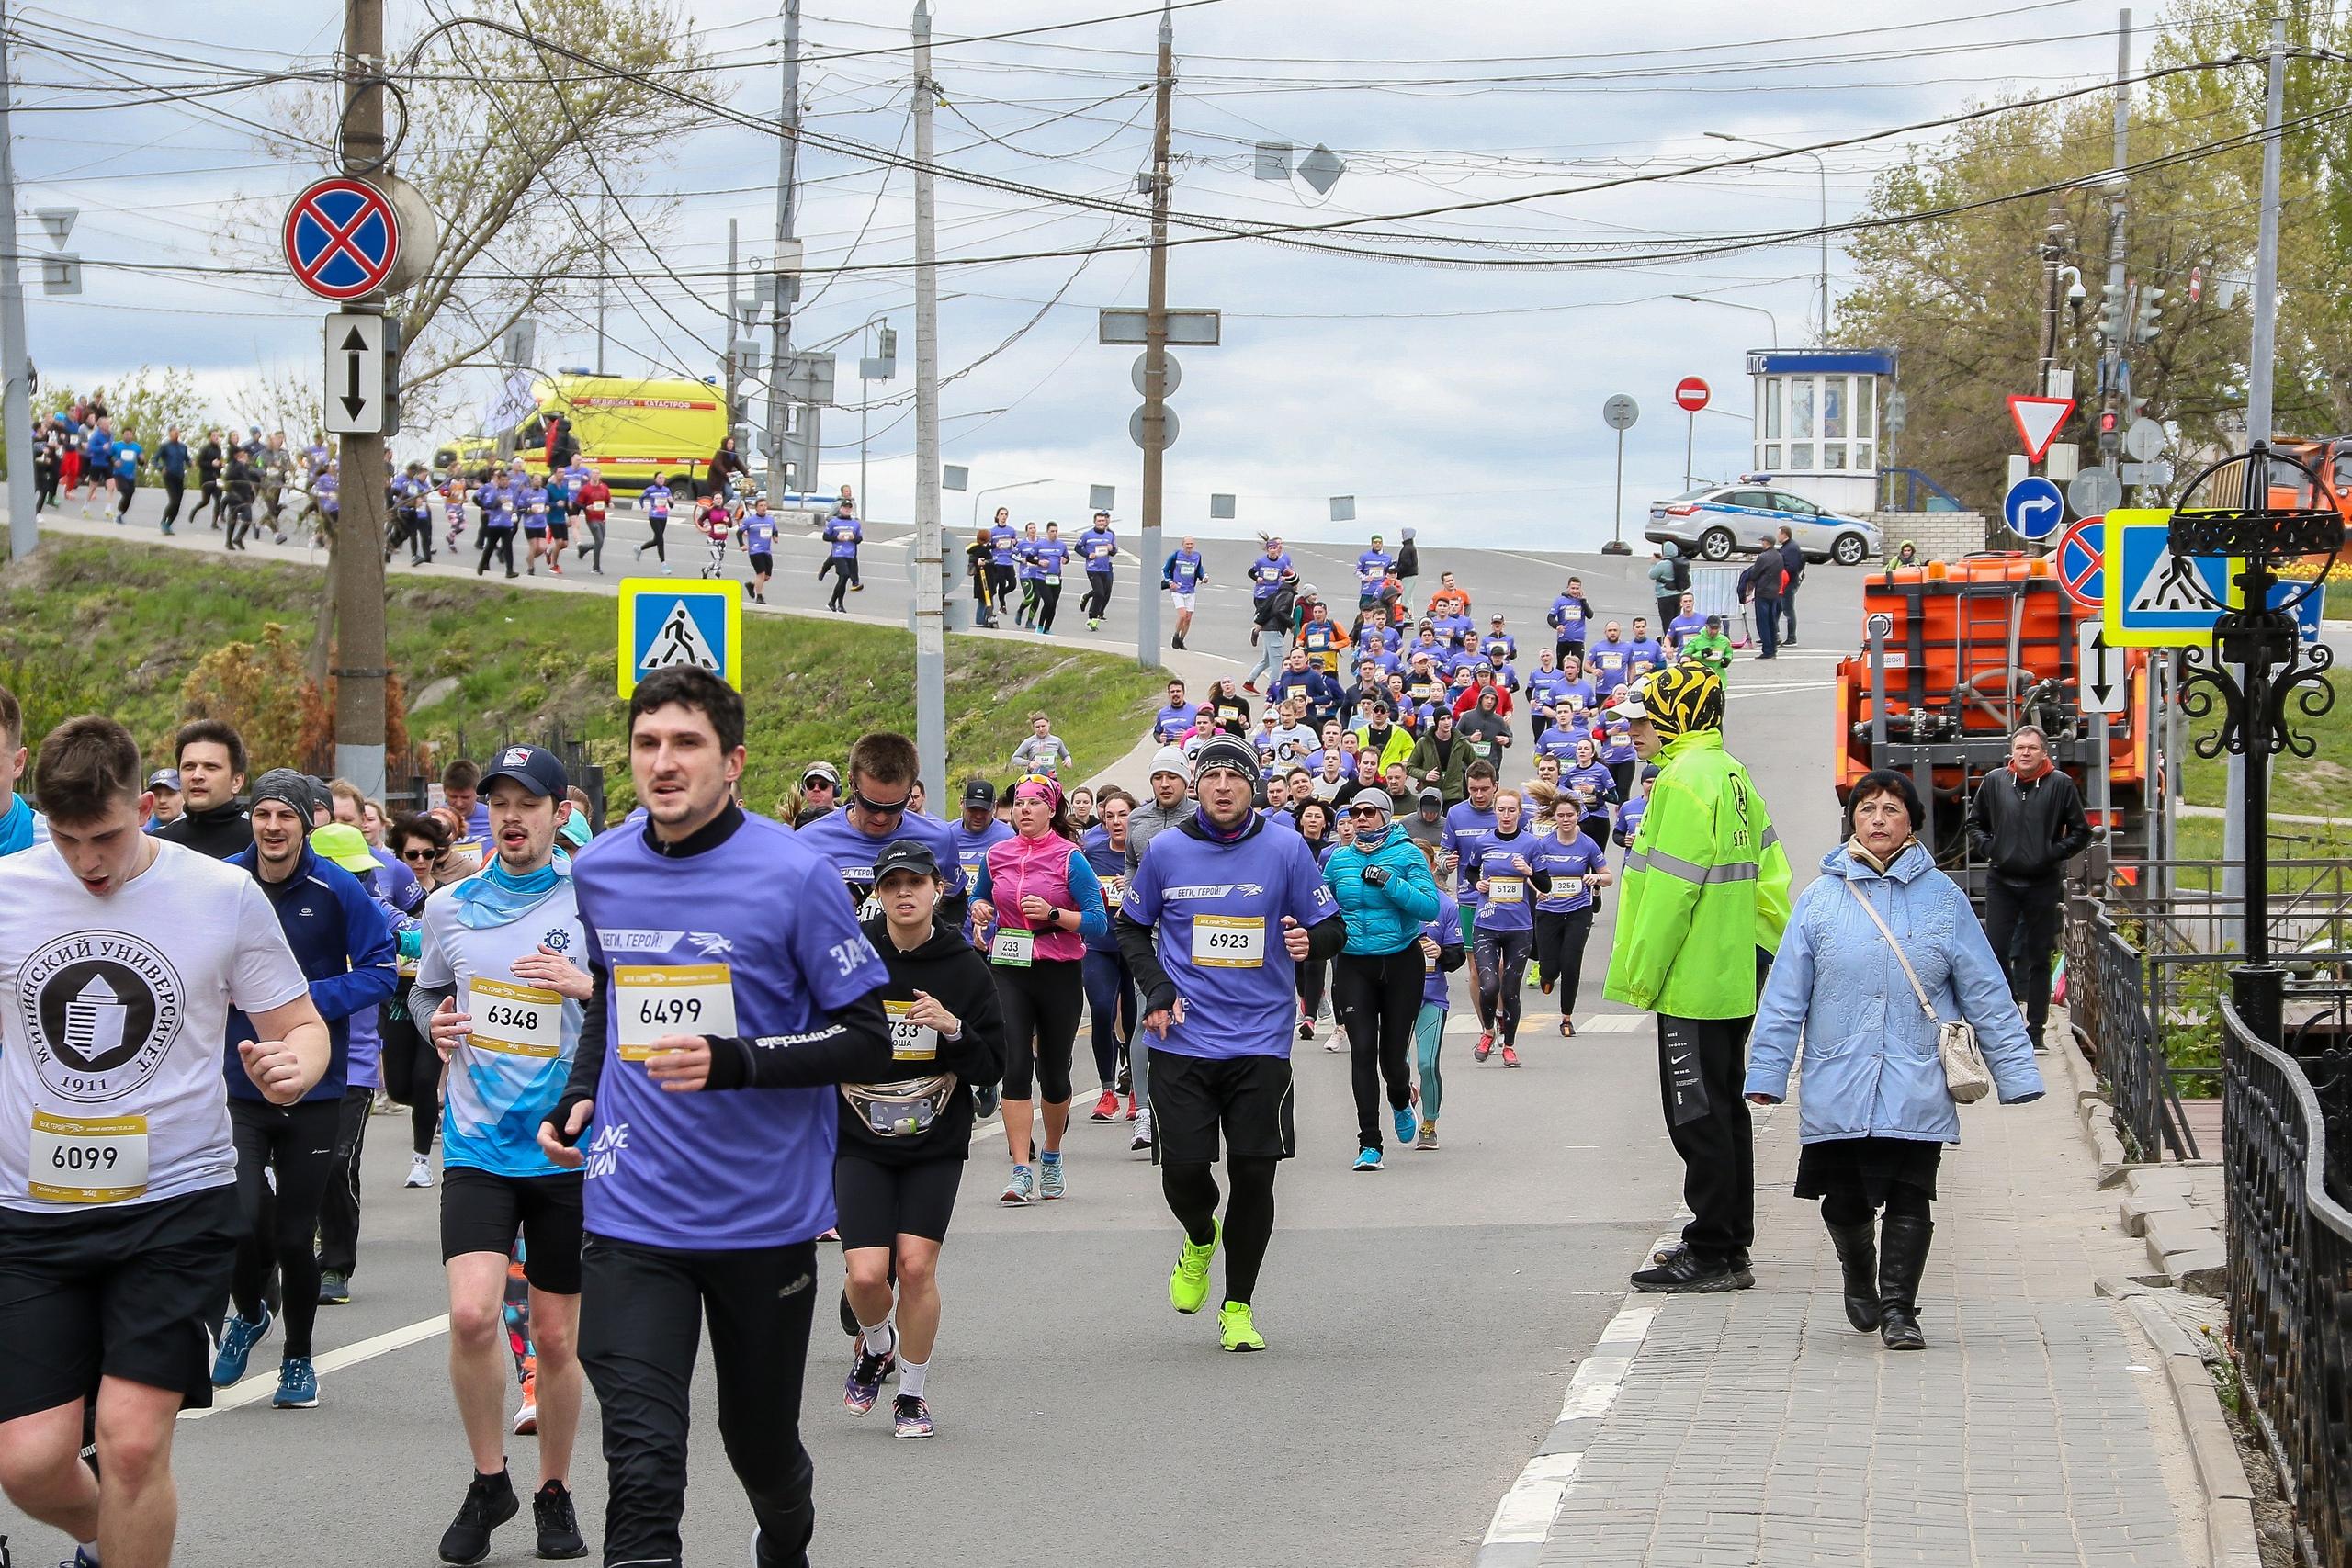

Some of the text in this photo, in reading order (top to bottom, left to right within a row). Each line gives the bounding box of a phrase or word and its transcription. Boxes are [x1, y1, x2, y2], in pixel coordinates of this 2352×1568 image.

[644, 400, 691, 409] КАТАСТРОФ
[1177, 886, 1222, 897] БЕГИ, ГЕРОЙ!
[1480, 907, 1495, 919] RUN
[602, 931, 663, 948] БЕГИ, ГЕРОЙ!
[1002, 941, 1019, 952] 233
[1209, 933, 1249, 949] 6923
[22, 939, 176, 1073] МИНИНСКИЙ УНИВЕРСИТЕТ
[640, 998, 702, 1024] 6499
[488, 1005, 538, 1030] 6348
[892, 1039, 912, 1047] ОША
[61, 1076, 109, 1092] 1911
[51, 1146, 119, 1170] 6099
